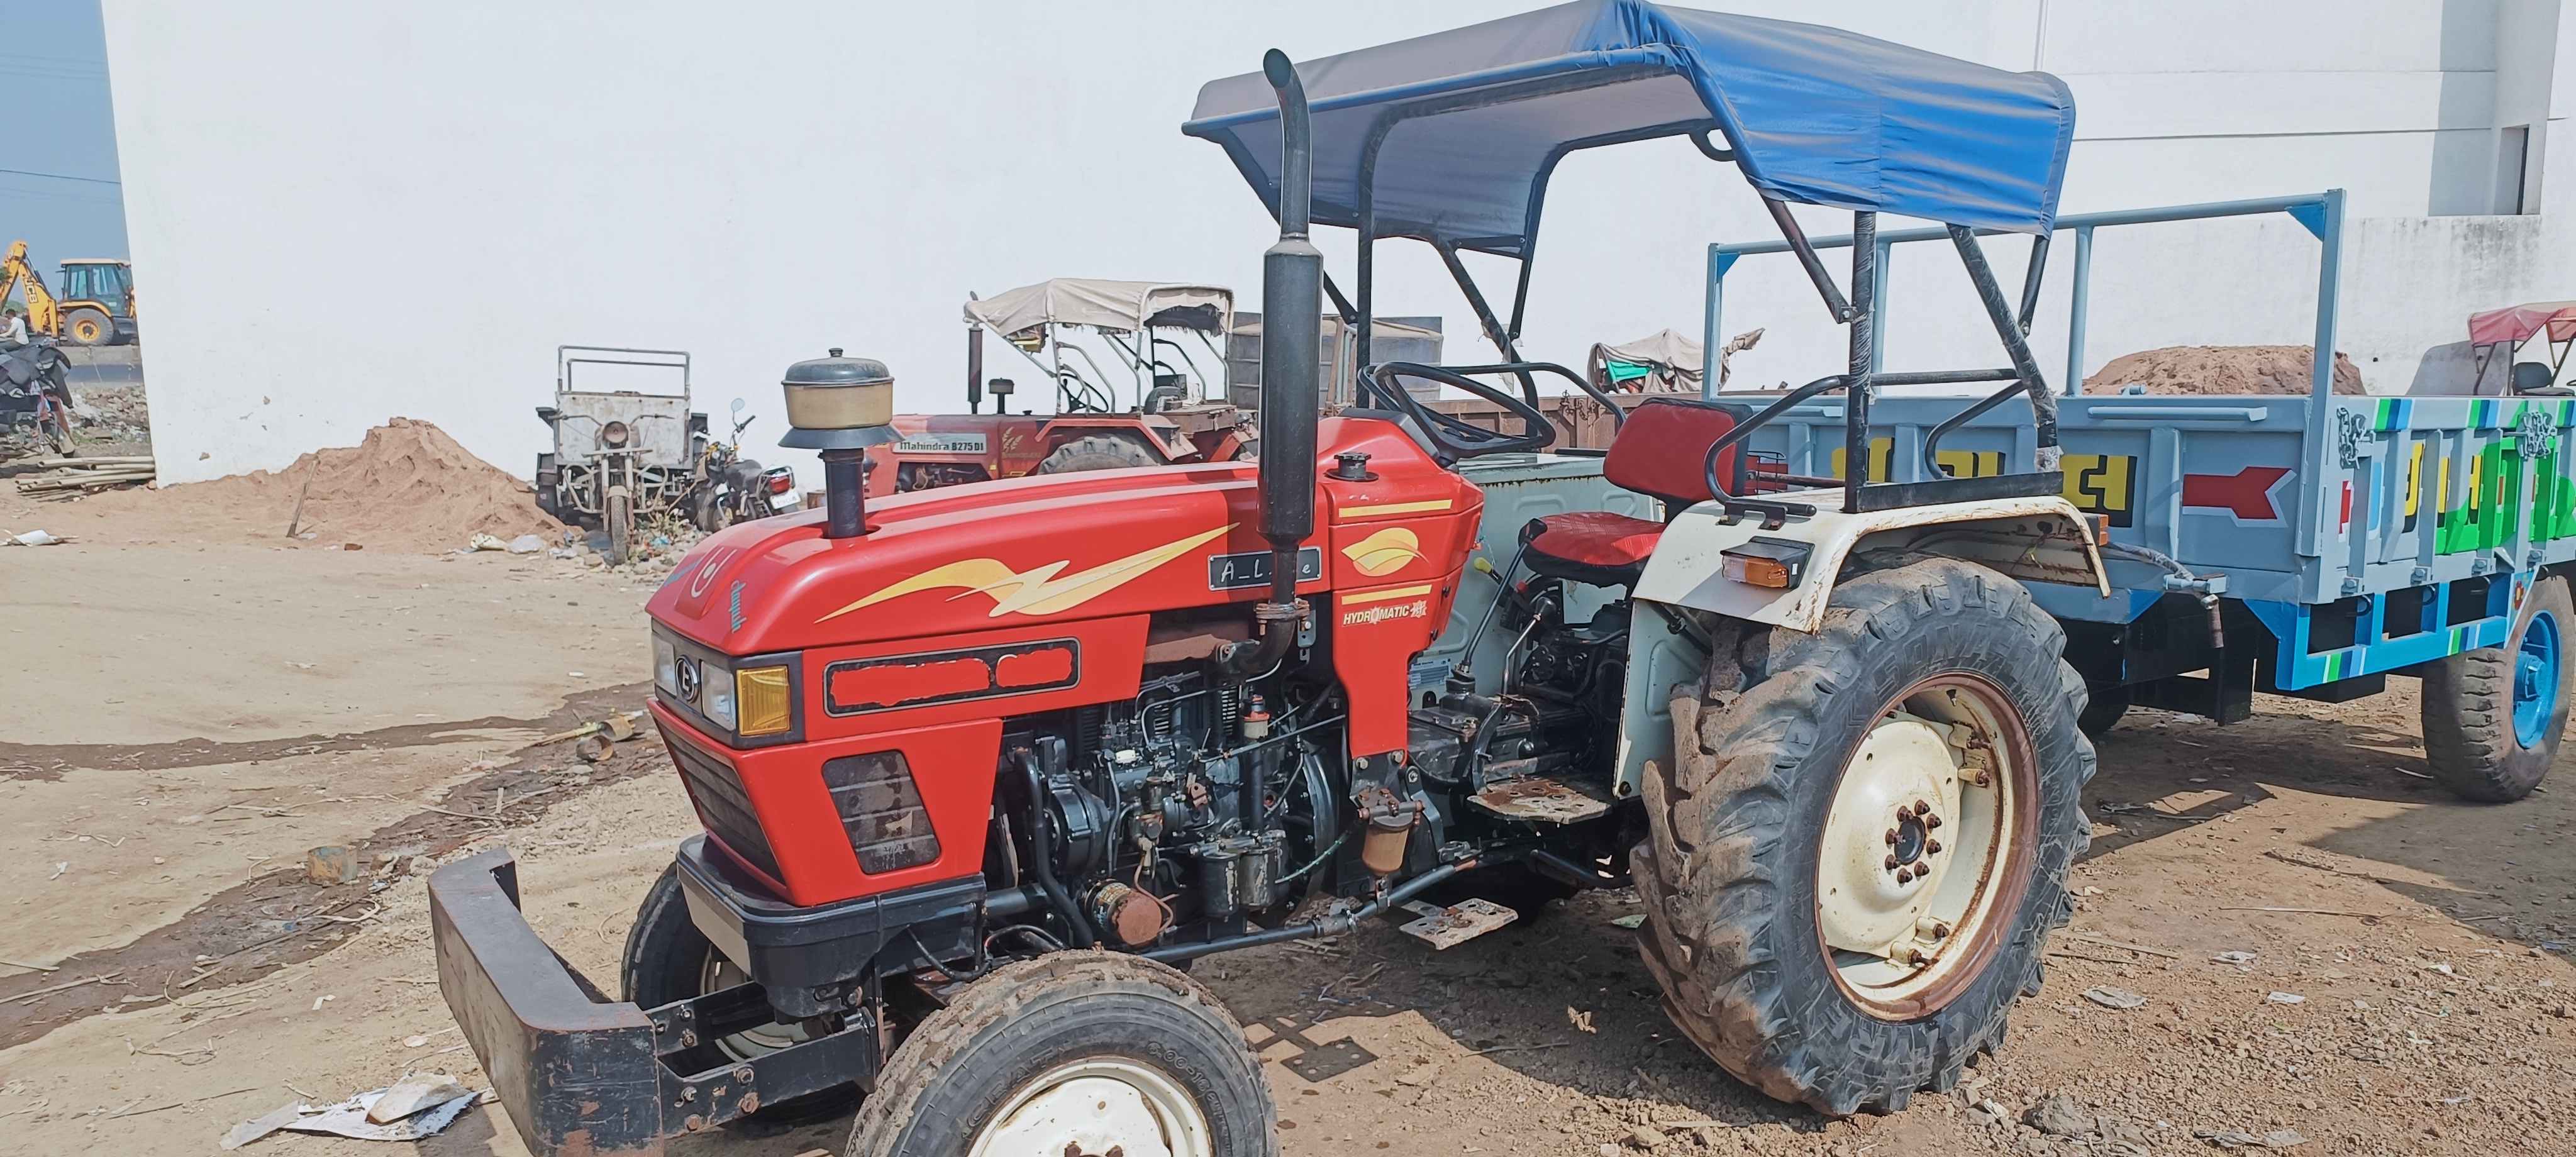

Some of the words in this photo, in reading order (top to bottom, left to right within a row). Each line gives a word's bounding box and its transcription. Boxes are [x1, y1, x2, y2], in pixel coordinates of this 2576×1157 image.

[900, 442, 950, 451] Mahindra
[1343, 604, 1409, 625] HYDROMATIC
[1147, 1041, 1211, 1092] 6.00-16
[967, 1046, 1055, 1127] CEAT
